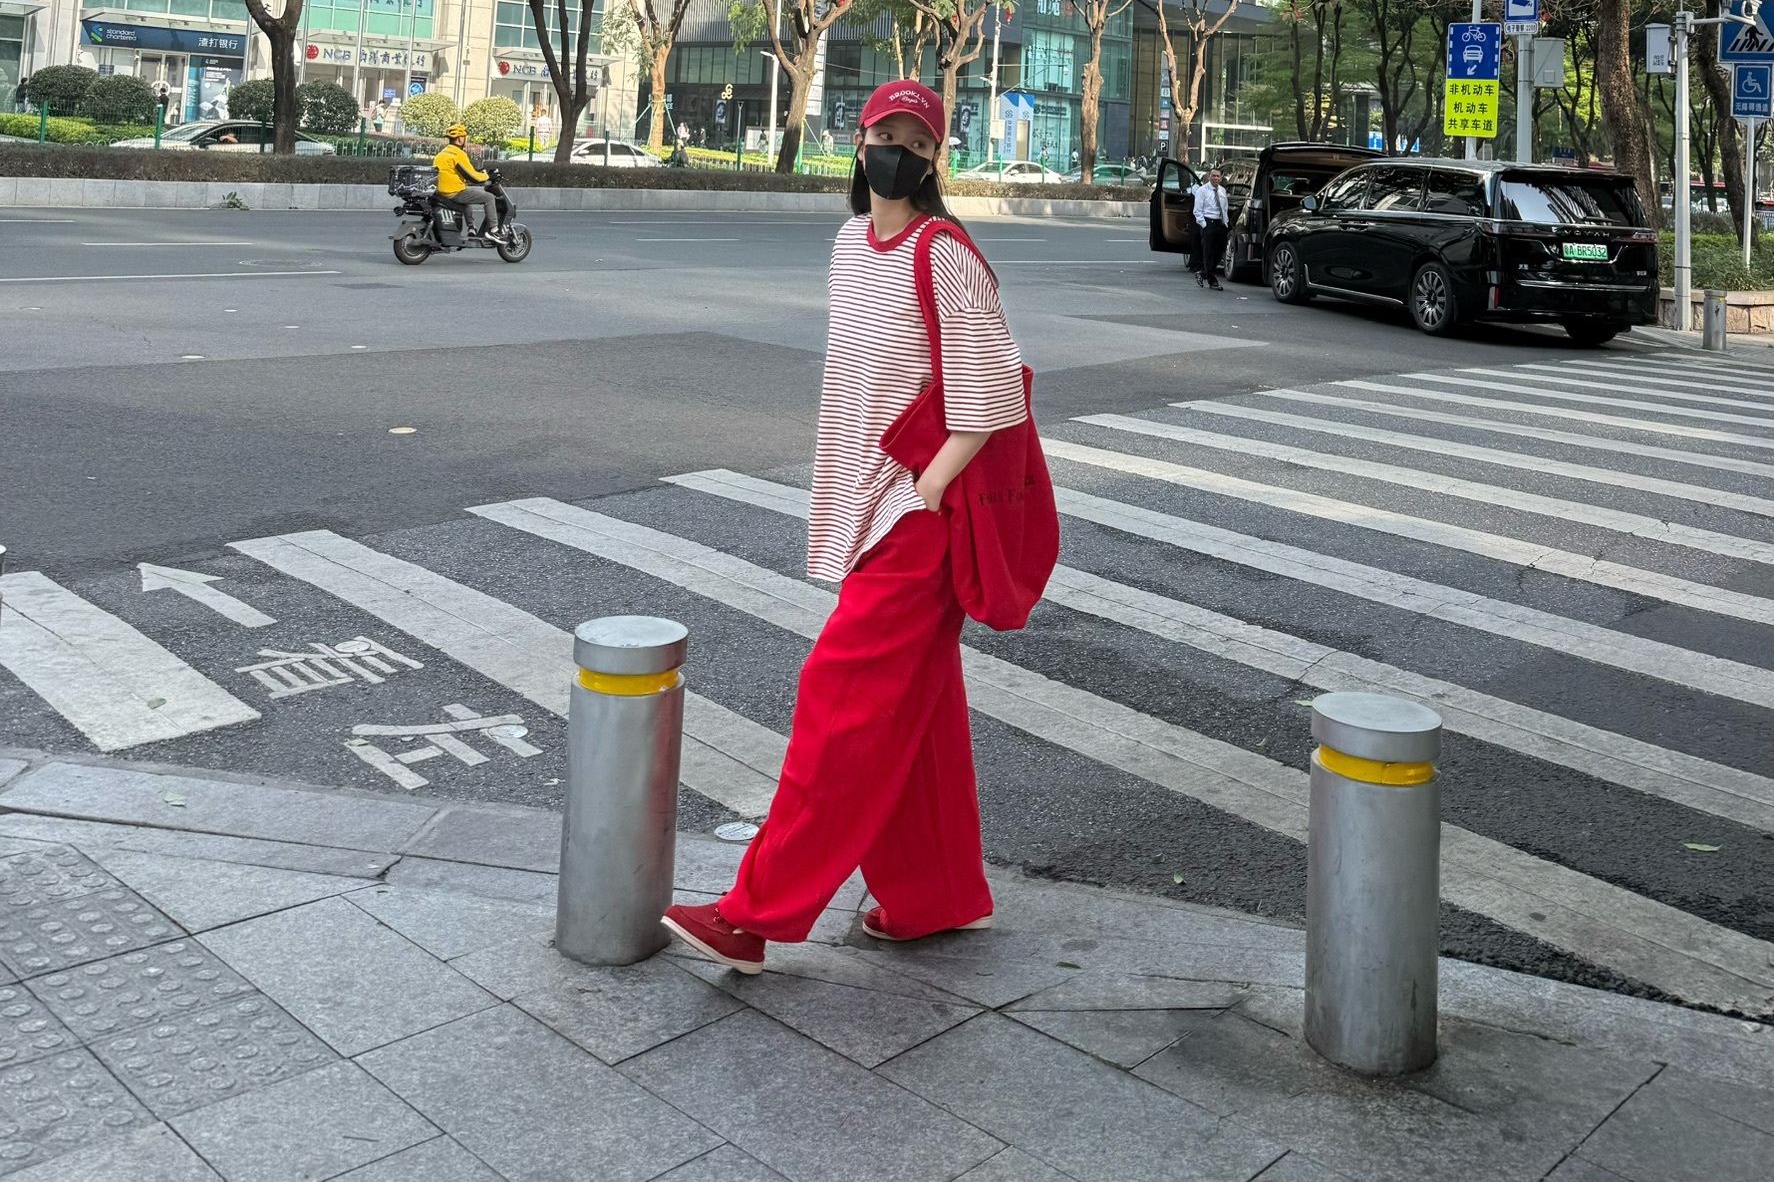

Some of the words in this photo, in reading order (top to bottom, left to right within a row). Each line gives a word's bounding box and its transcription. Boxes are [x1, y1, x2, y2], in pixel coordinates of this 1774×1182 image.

[198, 37, 239, 50] 渣打银行
[322, 47, 352, 62] NCB
[1448, 83, 1495, 96] 非机动车
[888, 89, 930, 109] BROOKLYN
[1453, 101, 1489, 115] 机动车
[1734, 102, 1769, 113] 无障碍通道
[1447, 118, 1495, 132] 共享车道
[1564, 229, 1611, 238] VOYAH
